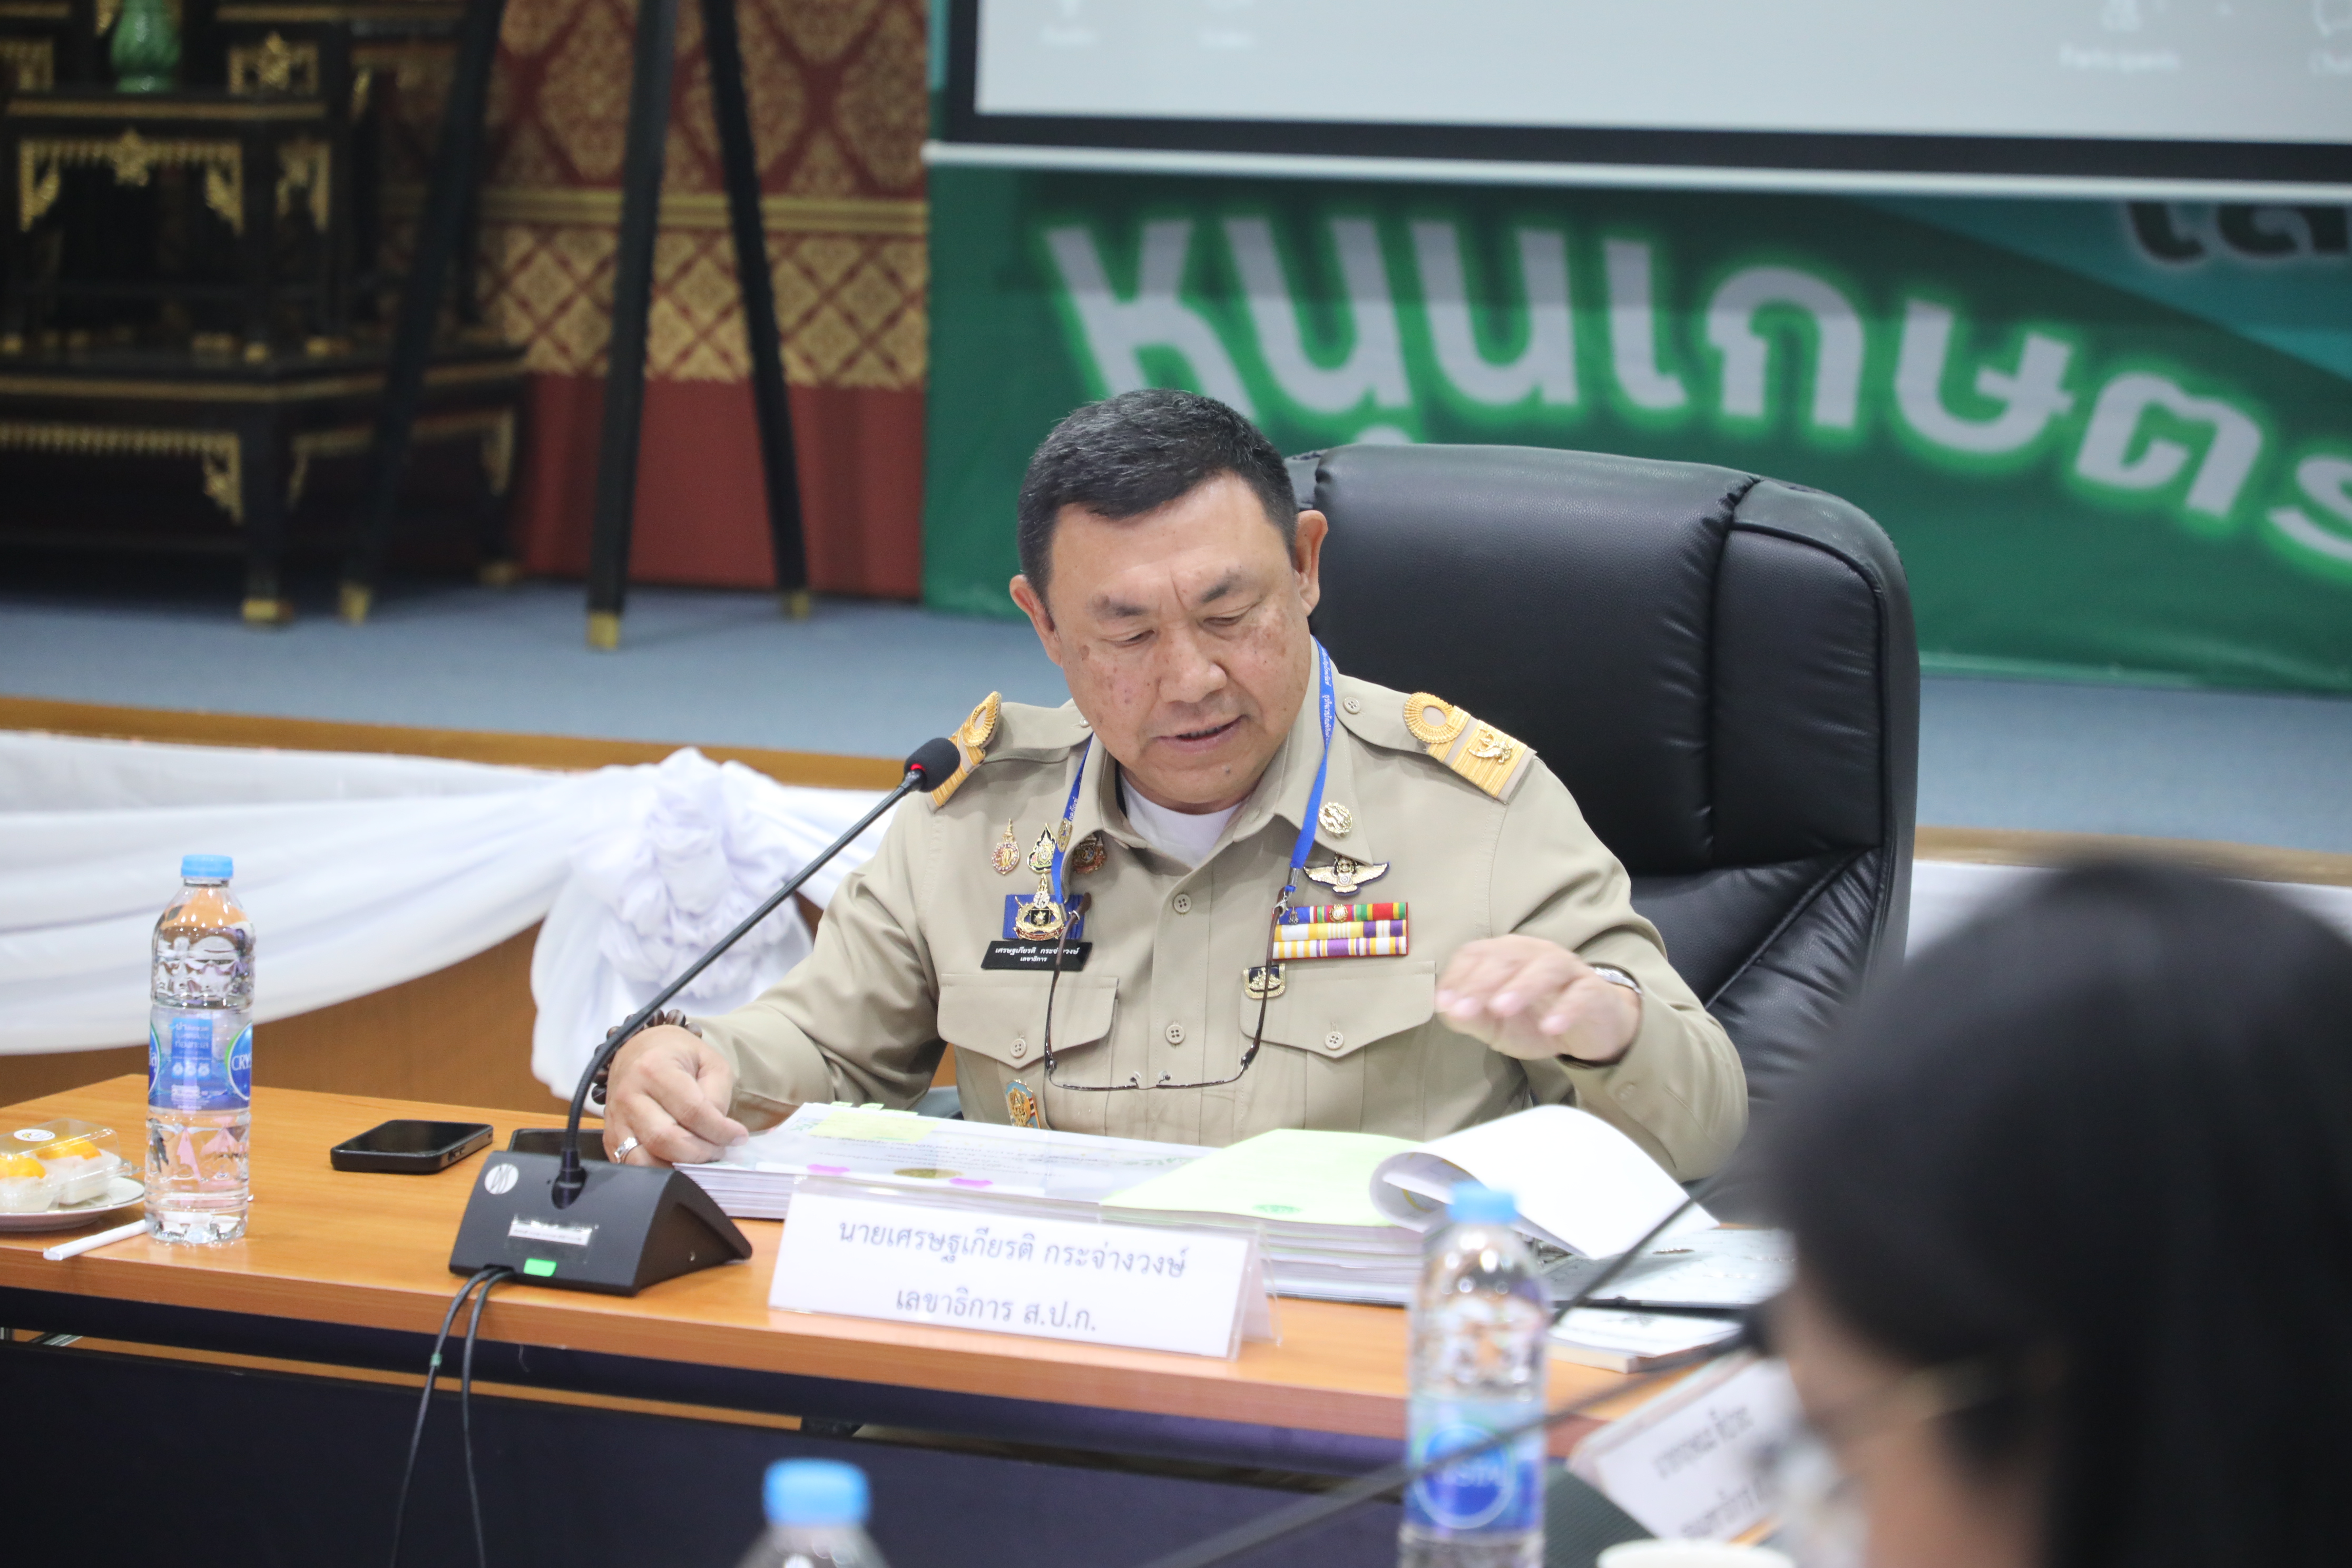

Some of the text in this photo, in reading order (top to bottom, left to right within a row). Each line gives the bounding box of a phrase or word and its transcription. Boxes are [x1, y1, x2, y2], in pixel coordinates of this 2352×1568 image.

[995, 946, 1036, 956] เศรษฐเกียรติ
[839, 1221, 1189, 1278] นายเศรษฐเกียรติ กระจ่างวงษ์
[896, 1287, 1096, 1332] เลขาธิการ ส.ป.ก.
